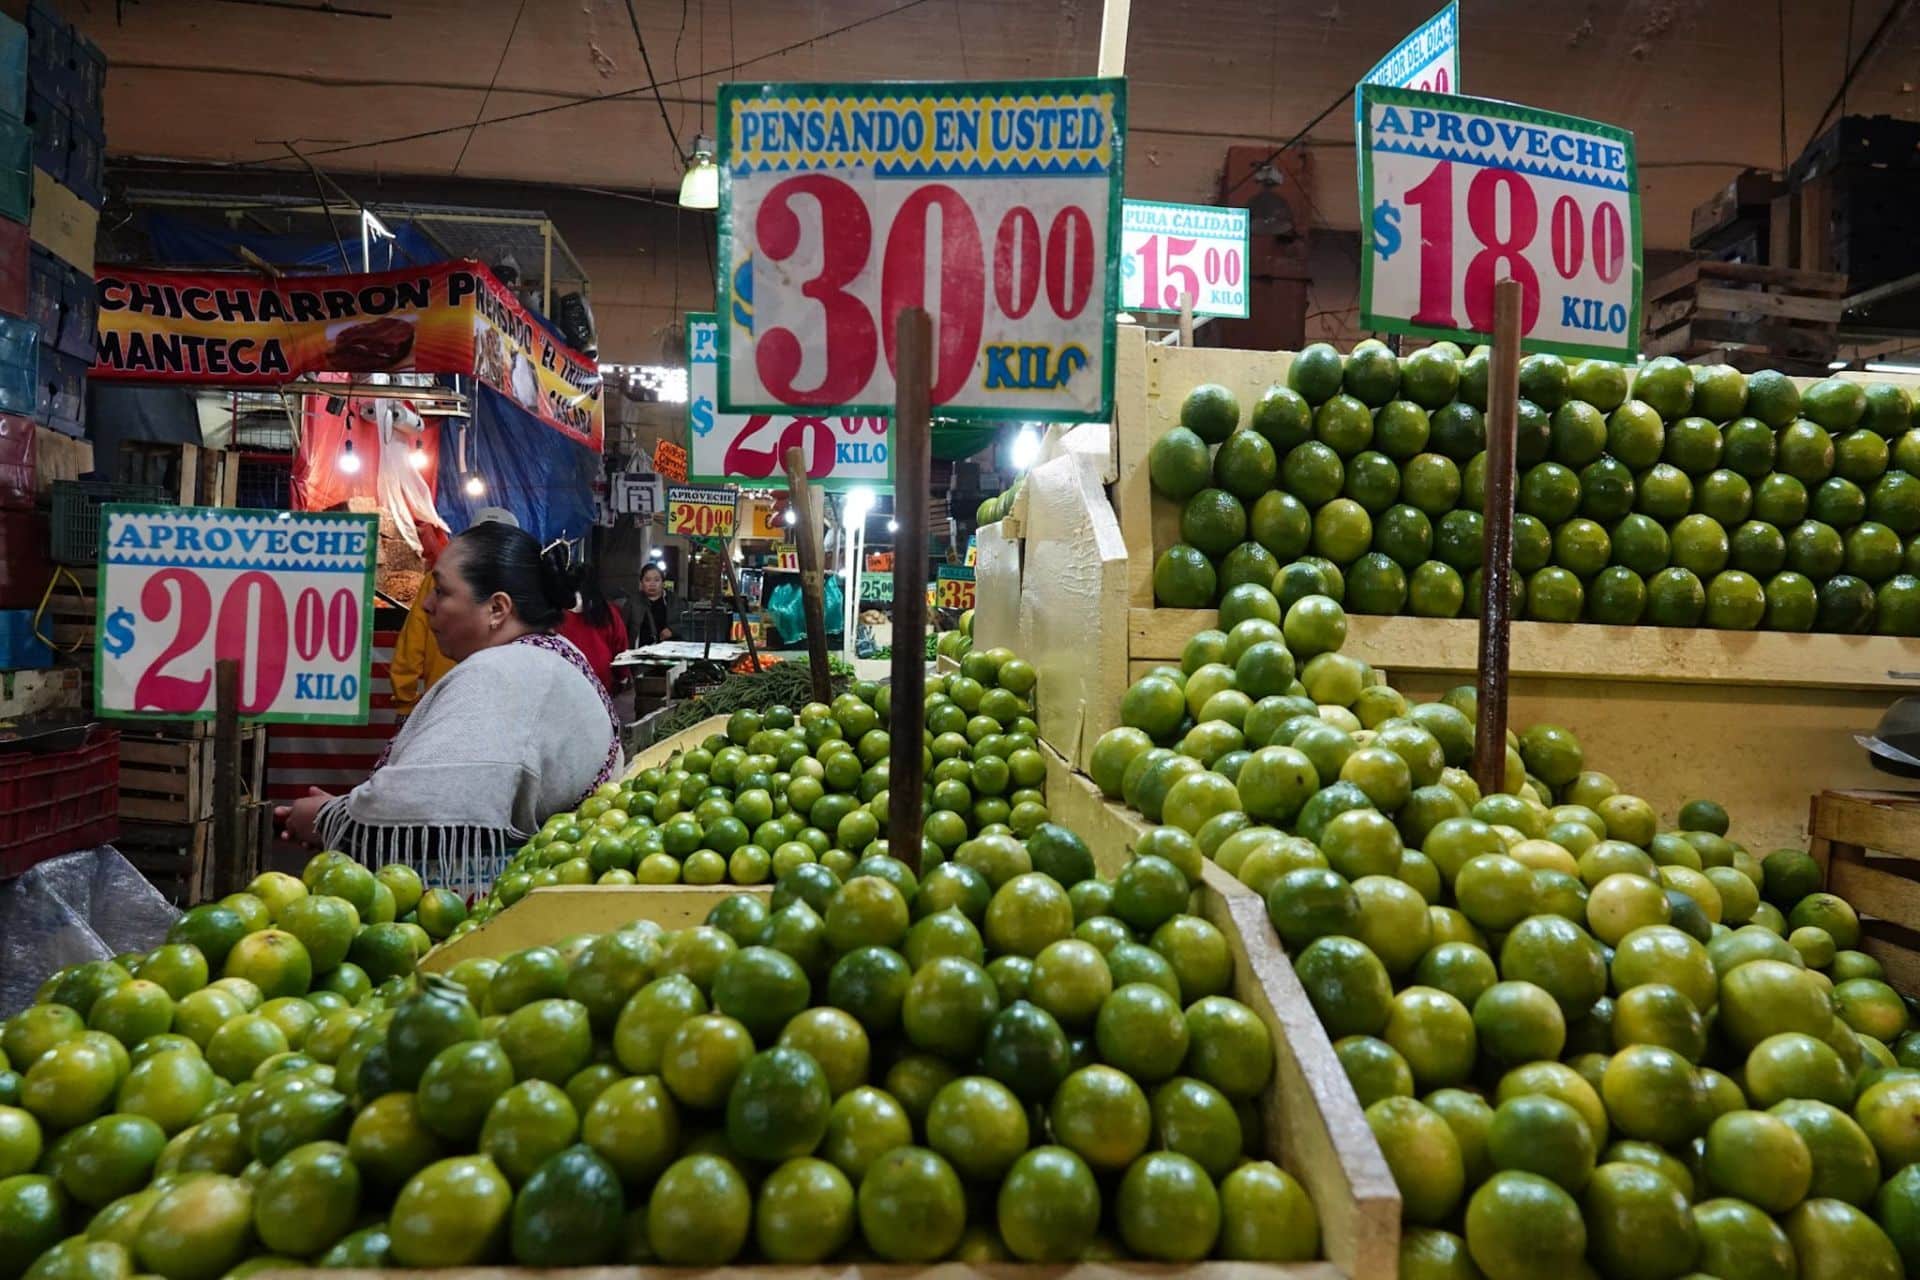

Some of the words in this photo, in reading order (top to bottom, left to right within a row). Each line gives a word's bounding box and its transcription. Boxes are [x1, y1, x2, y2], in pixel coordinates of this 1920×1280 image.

[1407, 40, 1425, 68] DEL
[740, 110, 924, 153] PENSANDO
[934, 110, 981, 151] EN
[991, 107, 1105, 151] USTED
[1375, 106, 1627, 174] APROVECHE
[1125, 210, 1167, 226] PURA
[1173, 213, 1244, 232] CALIDAD
[97, 277, 431, 322] CHICHARRON
[1211, 289, 1243, 305] KILO
[1561, 295, 1627, 334] KILO
[91, 331, 290, 373] MANTECA
[836, 442, 888, 464] KILO
[670, 491, 734, 502] APROVECHE
[114, 524, 367, 556] APROVECHE
[295, 673, 358, 701] KILO
